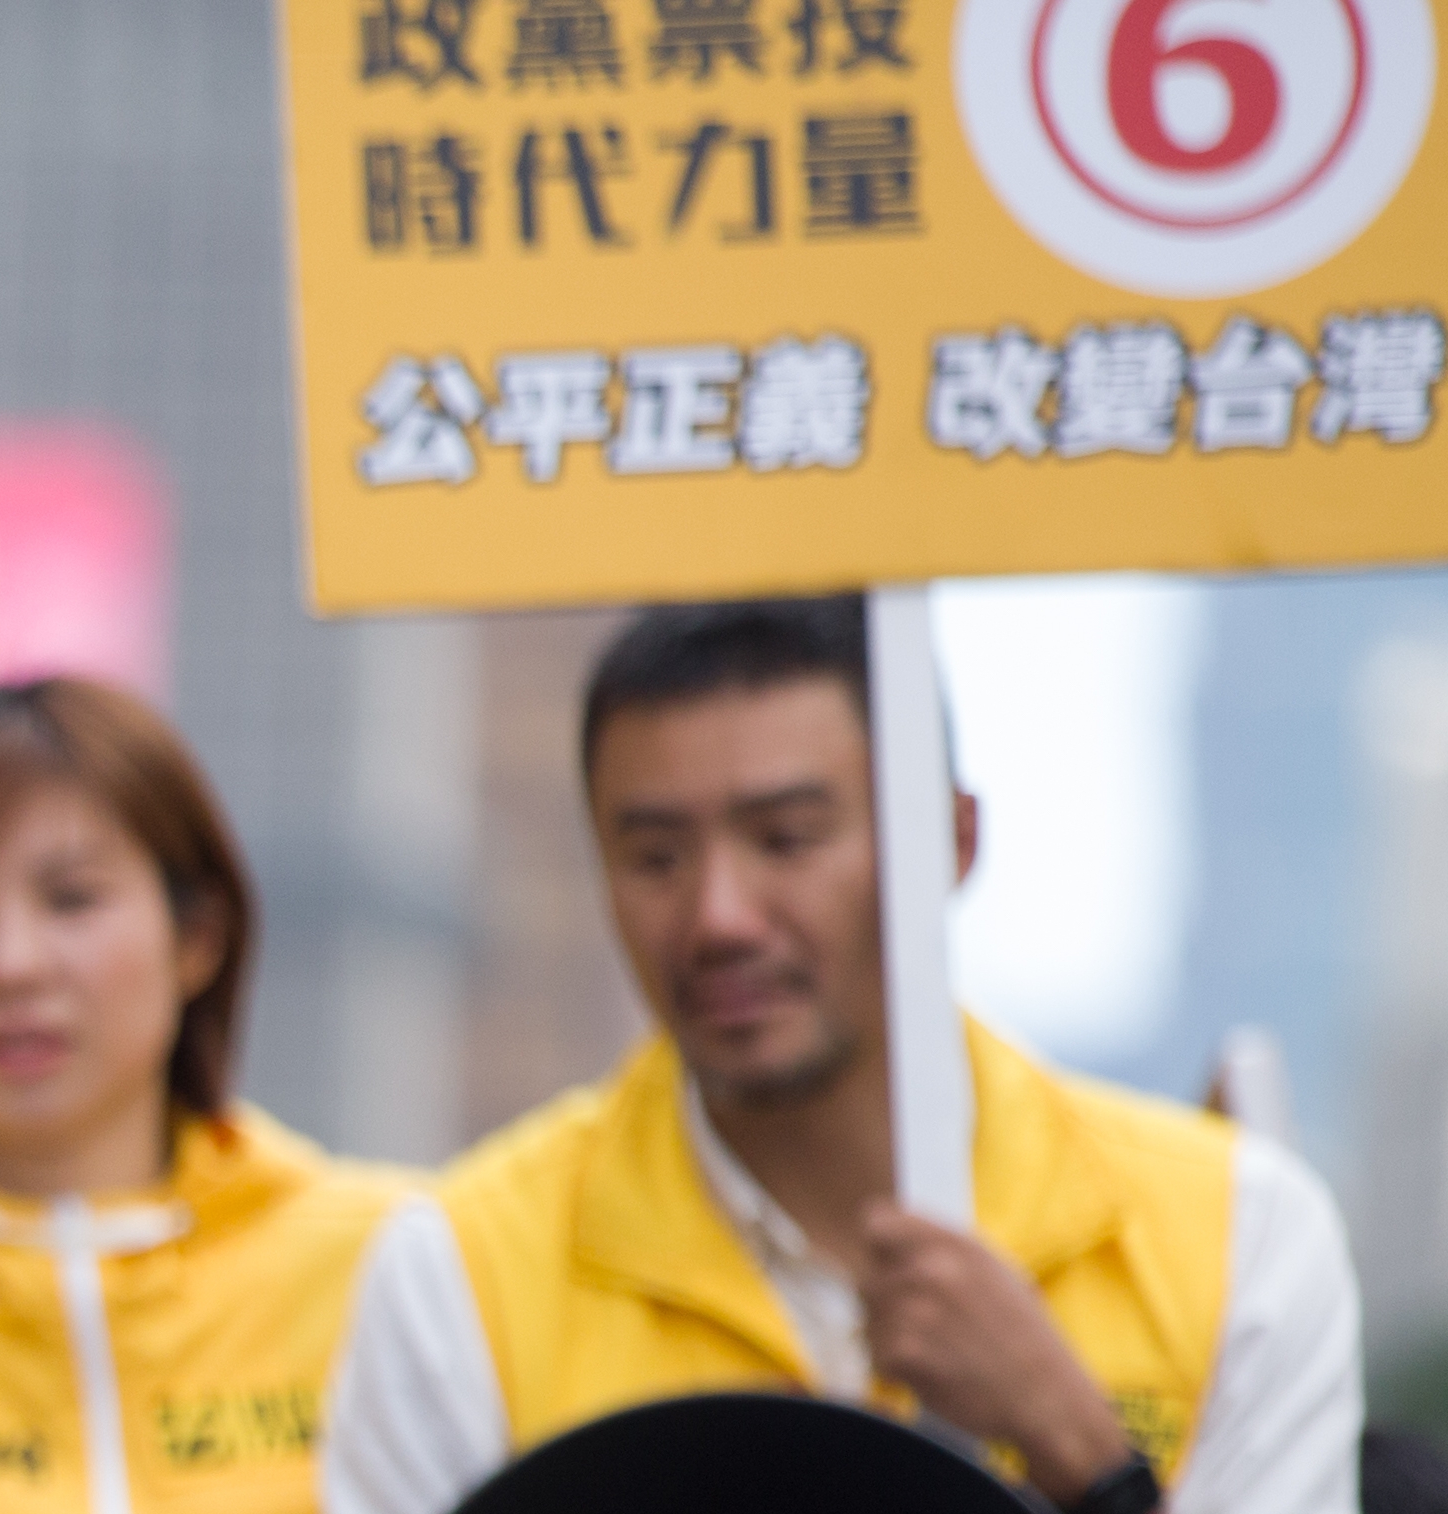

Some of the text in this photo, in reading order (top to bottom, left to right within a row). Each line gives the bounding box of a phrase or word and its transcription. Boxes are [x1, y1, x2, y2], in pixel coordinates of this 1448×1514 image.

[1107, 0, 1281, 174] 6
[362, 110, 923, 254] 時代力量
[356, 308, 1445, 487] 公平正義 改變台灣
